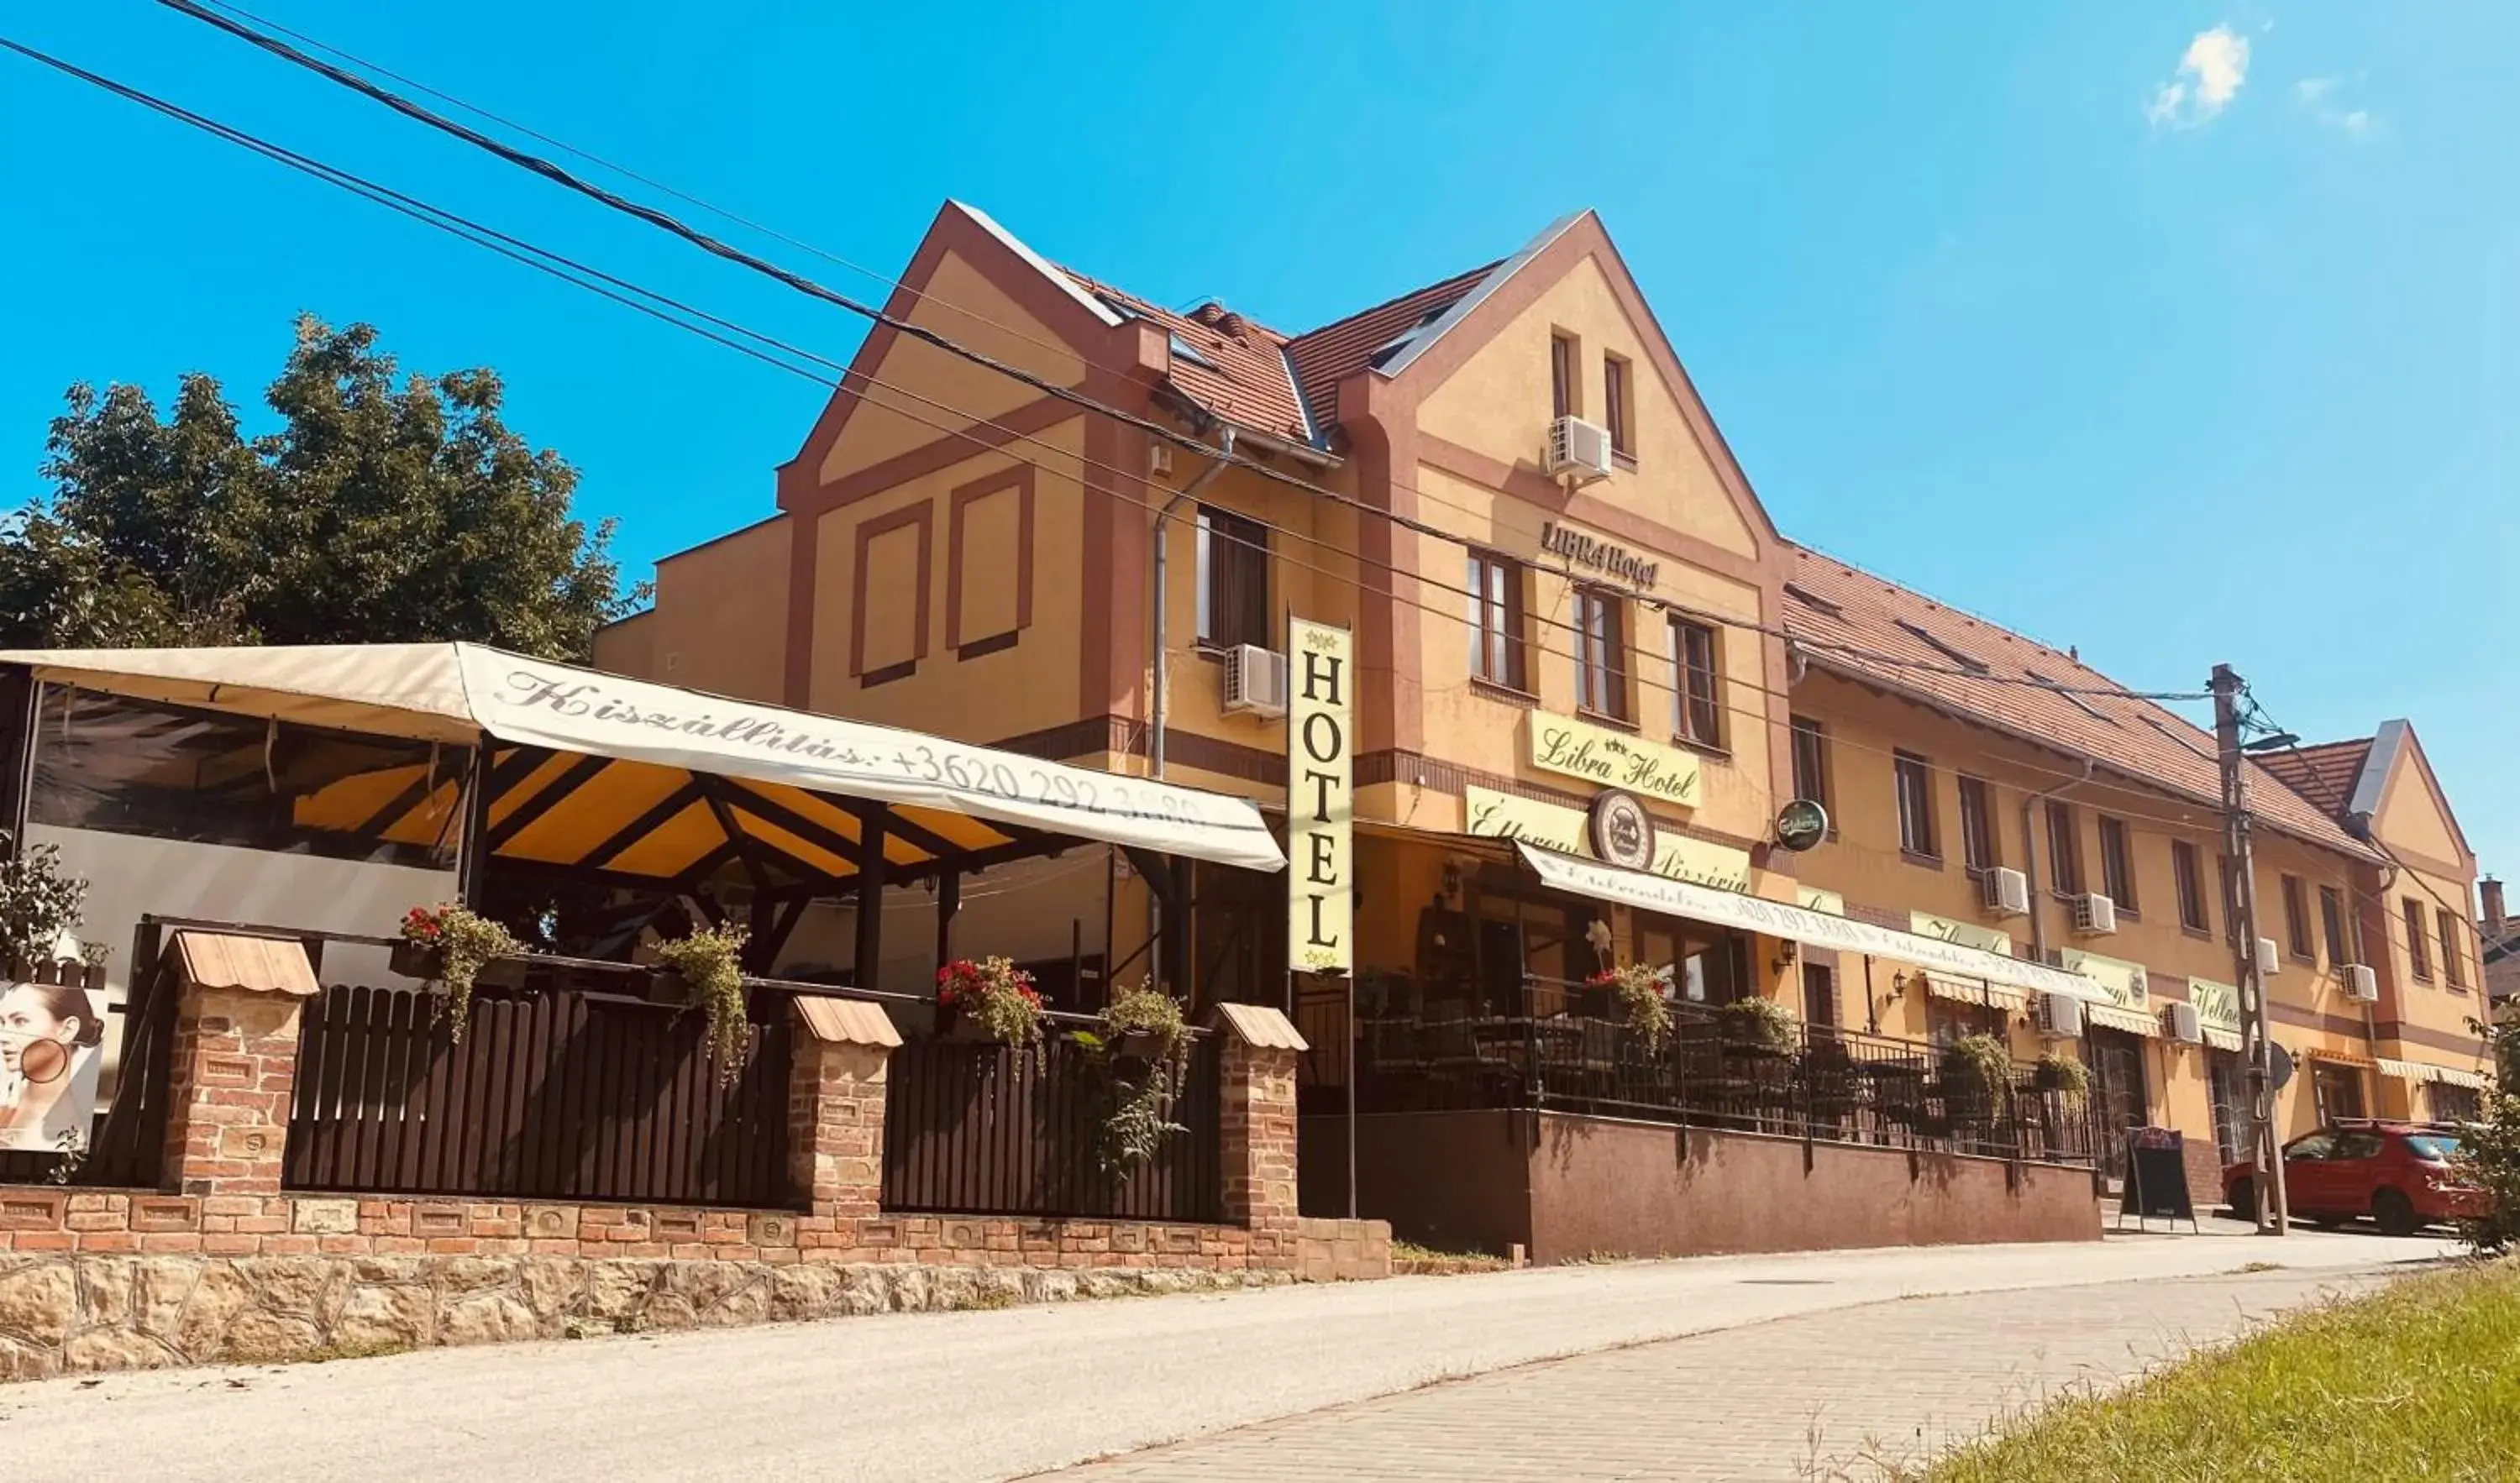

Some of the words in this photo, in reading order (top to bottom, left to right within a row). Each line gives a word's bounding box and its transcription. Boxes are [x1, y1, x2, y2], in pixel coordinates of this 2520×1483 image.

[893, 745, 1020, 799] +3620
[1030, 769, 1107, 815] 292
[1537, 727, 1613, 779] Libra
[1622, 753, 1697, 799] Hotel
[1301, 650, 1344, 949] HOTEL
[2191, 983, 2240, 1024] Wellne
